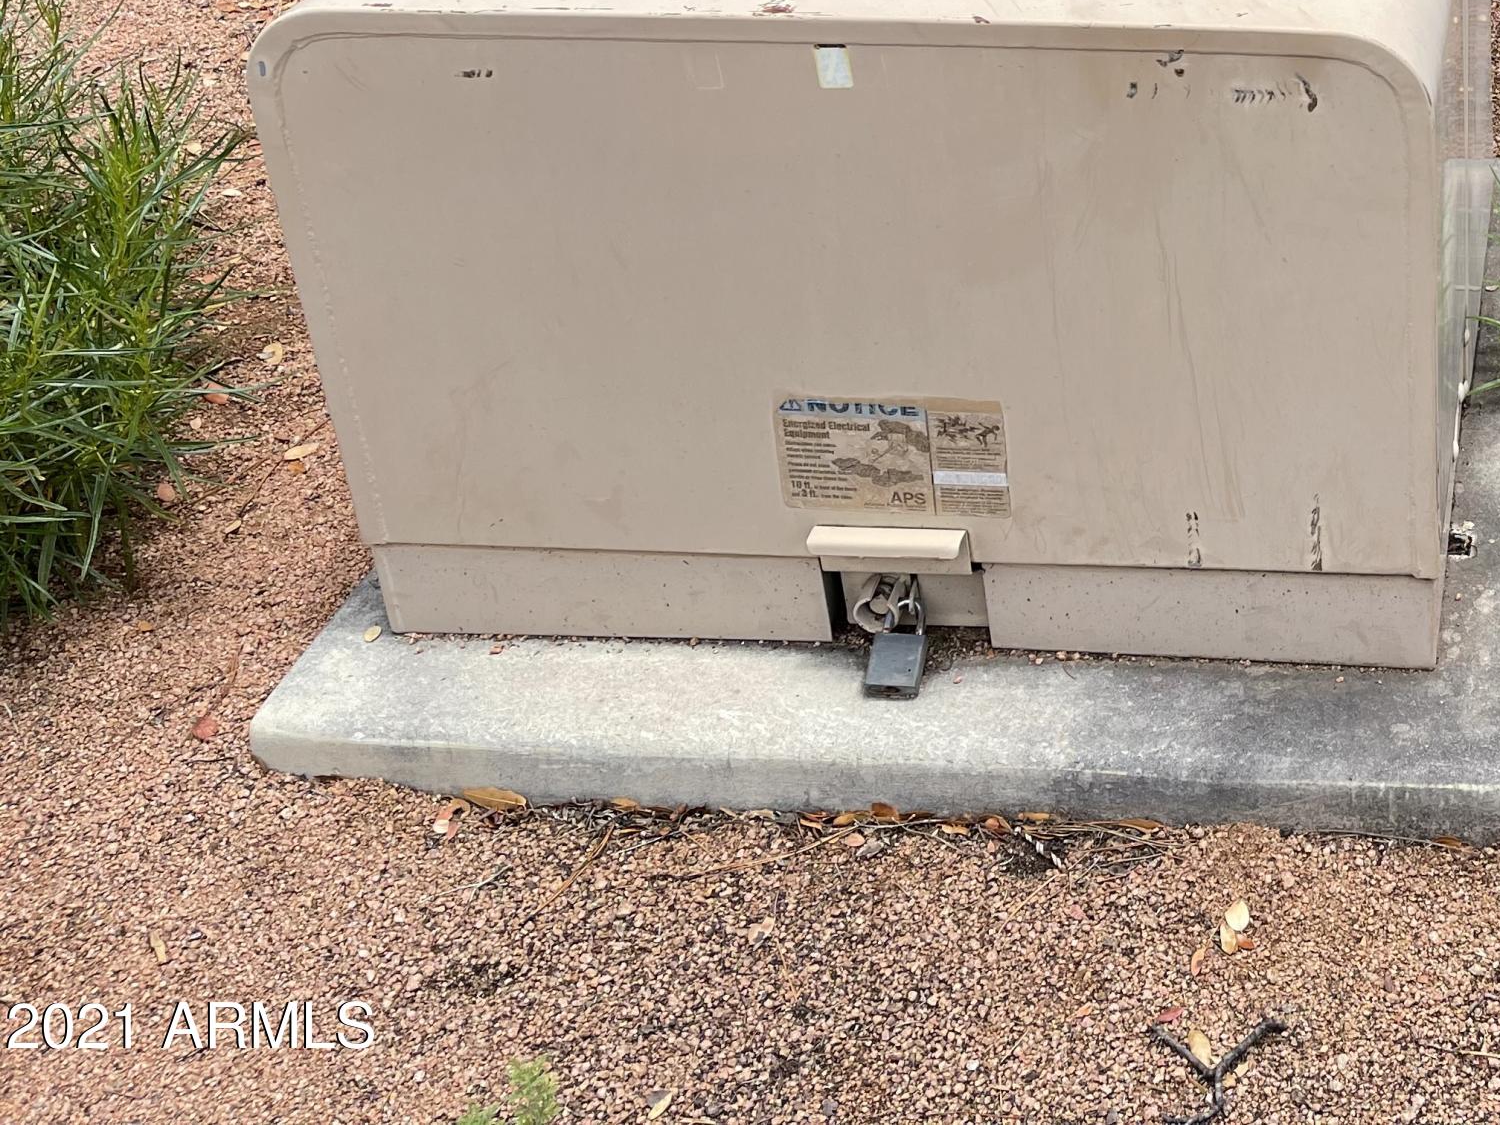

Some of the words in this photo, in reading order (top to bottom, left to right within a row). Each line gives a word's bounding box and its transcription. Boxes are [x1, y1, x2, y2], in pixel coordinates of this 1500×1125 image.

[782, 419, 826, 430] Energized
[828, 421, 871, 432] Electrical
[784, 428, 830, 440] Equipment
[890, 491, 926, 505] APS
